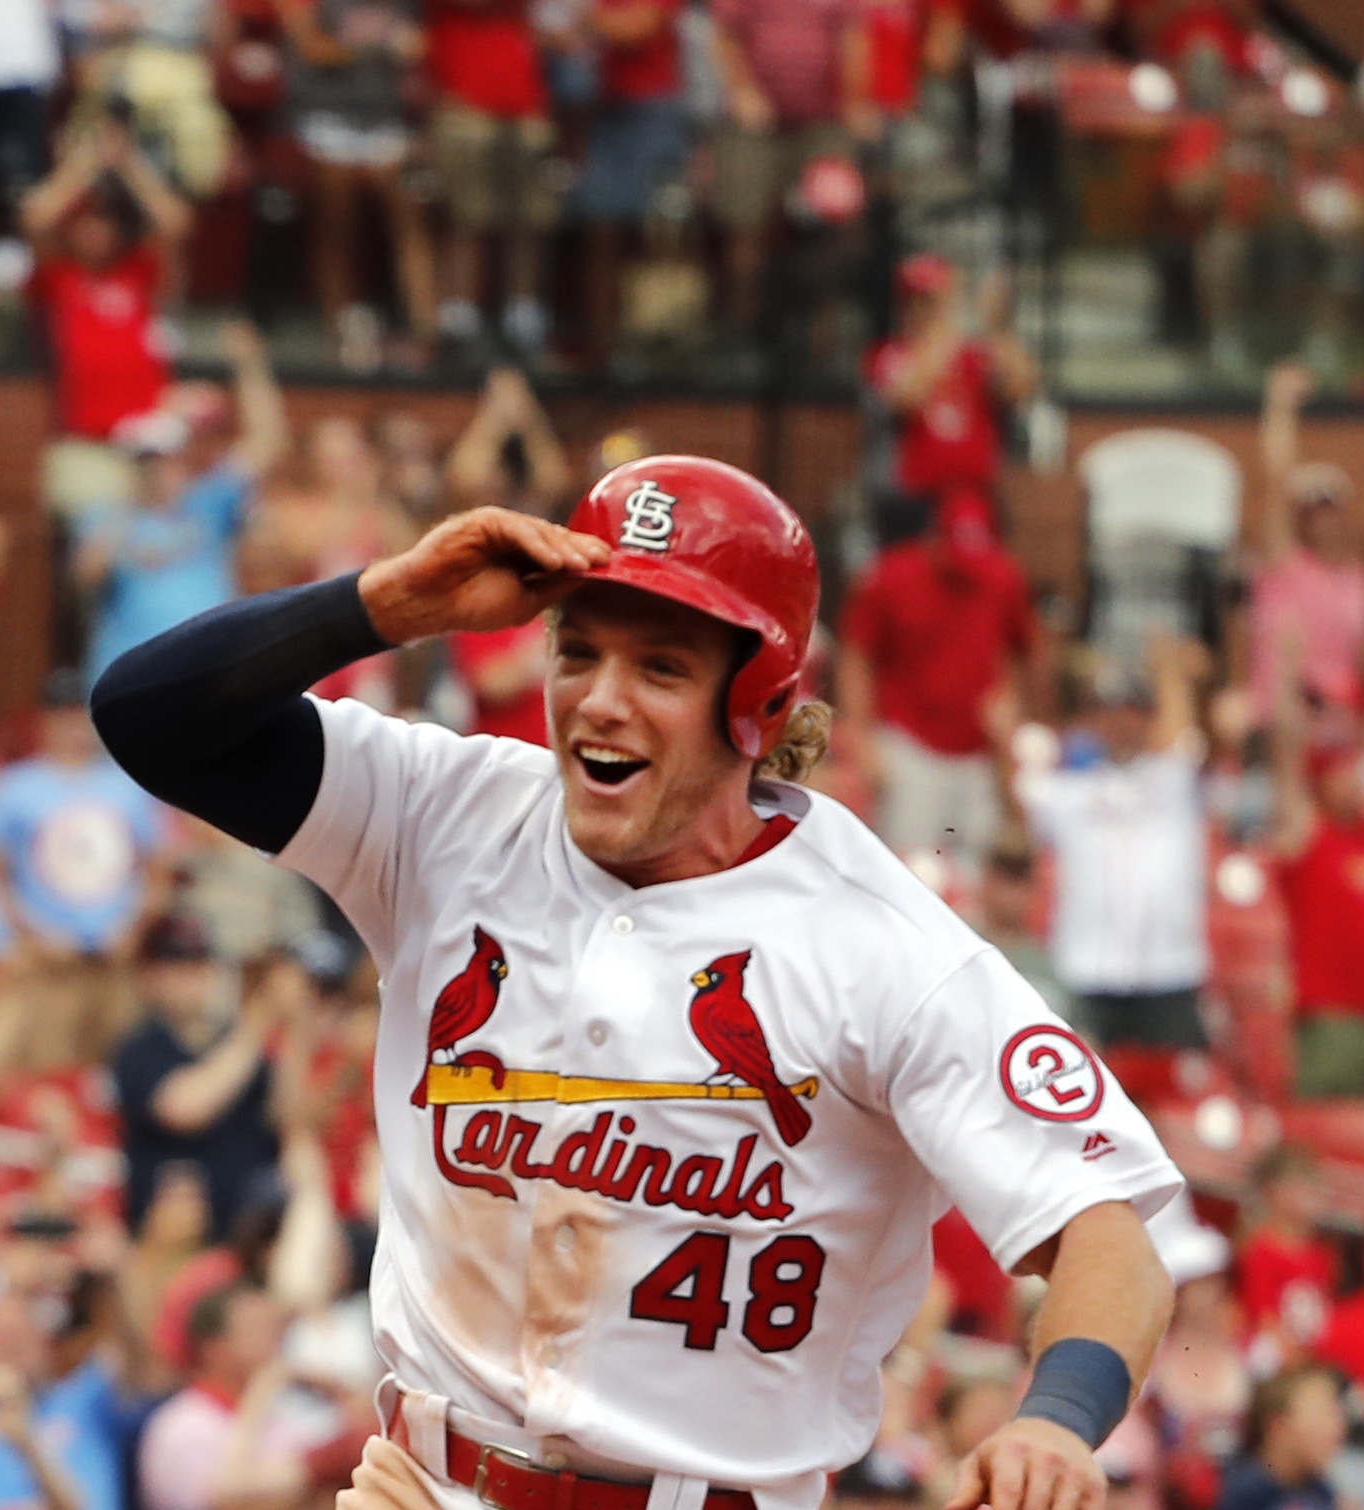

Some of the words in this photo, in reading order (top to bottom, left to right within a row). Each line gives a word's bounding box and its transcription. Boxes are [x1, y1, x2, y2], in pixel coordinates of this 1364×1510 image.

[433, 1050, 794, 1222] Cardinals
[1028, 1046, 1086, 1105] 2
[630, 1230, 825, 1353] 48
